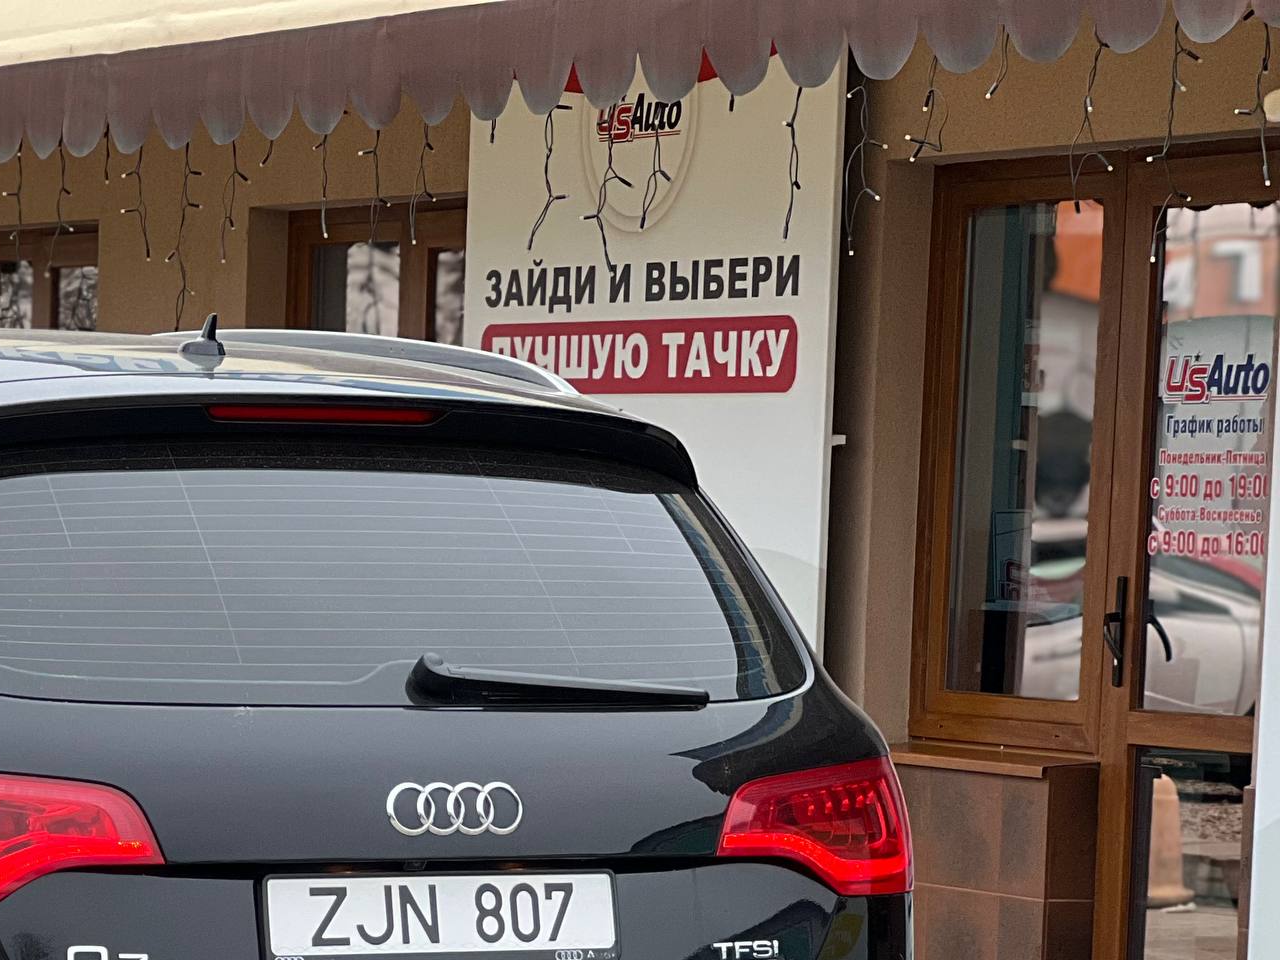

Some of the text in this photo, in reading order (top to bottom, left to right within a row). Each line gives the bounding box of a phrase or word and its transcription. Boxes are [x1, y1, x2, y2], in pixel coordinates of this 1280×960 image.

[485, 254, 800, 314] ЗАЙДИ И ВЫБЕРИ
[662, 329, 790, 379] ТАЧКУ
[1166, 414, 1264, 438] График работы
[1165, 474, 1198, 498] 9:00
[1203, 480, 1222, 501] до
[1163, 530, 1195, 554] 9:00
[1201, 537, 1219, 557] до
[309, 882, 574, 947] ZJN 807
[712, 940, 779, 960] TFSI
